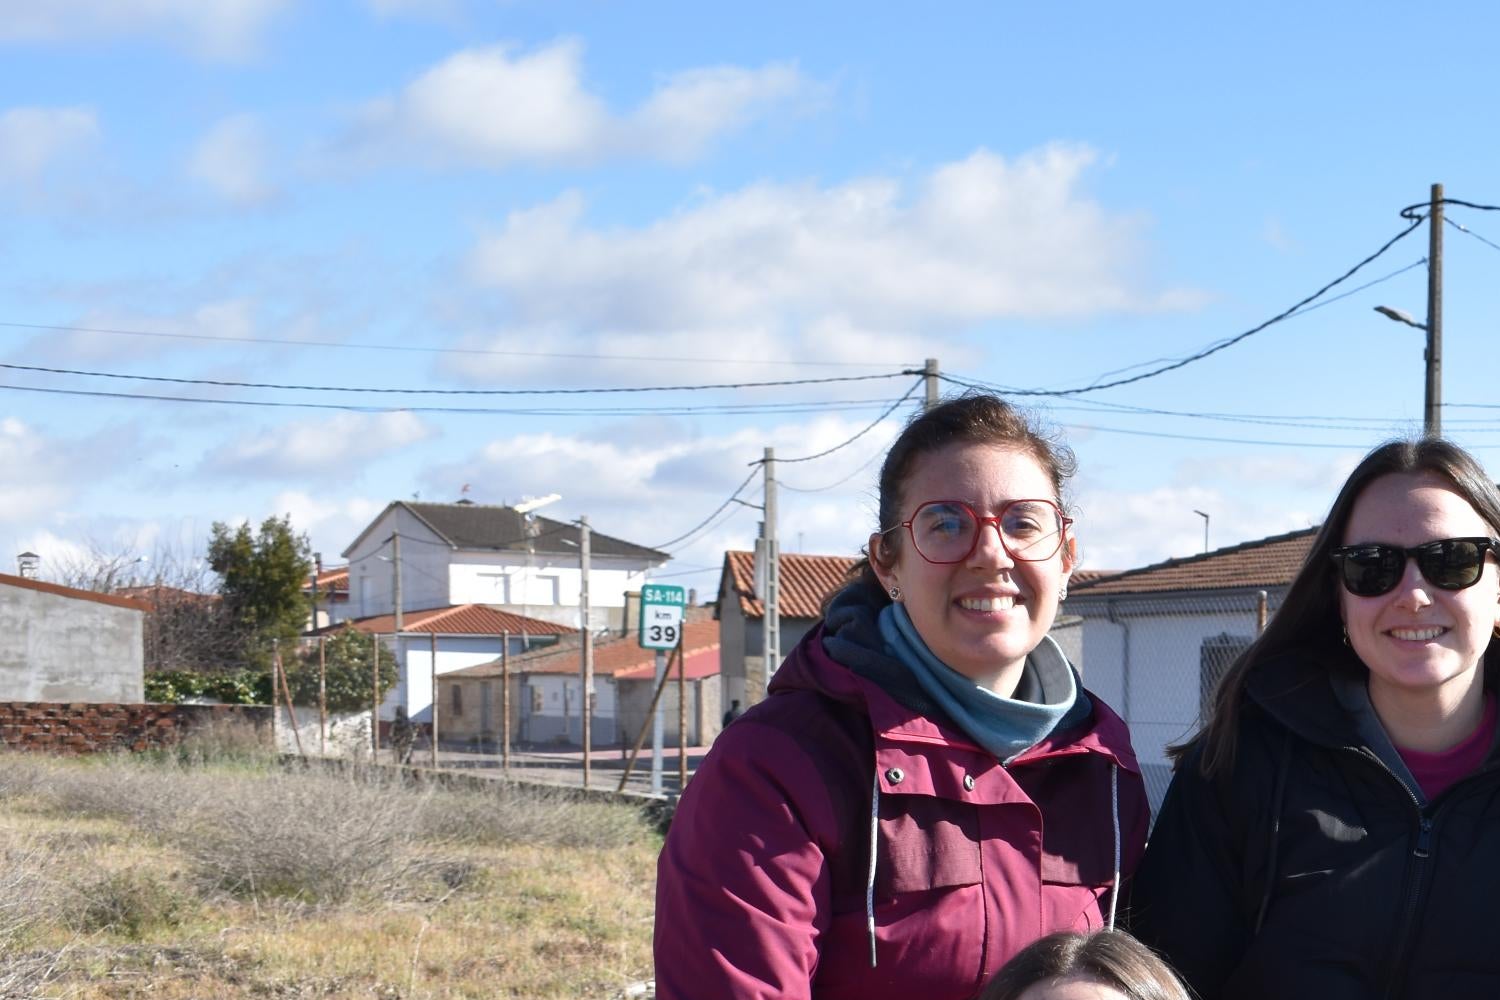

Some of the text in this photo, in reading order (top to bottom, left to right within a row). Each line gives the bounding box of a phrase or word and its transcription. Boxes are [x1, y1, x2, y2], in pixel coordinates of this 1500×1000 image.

[645, 589, 682, 603] SA-114
[655, 610, 672, 620] km
[650, 625, 675, 642] 39
